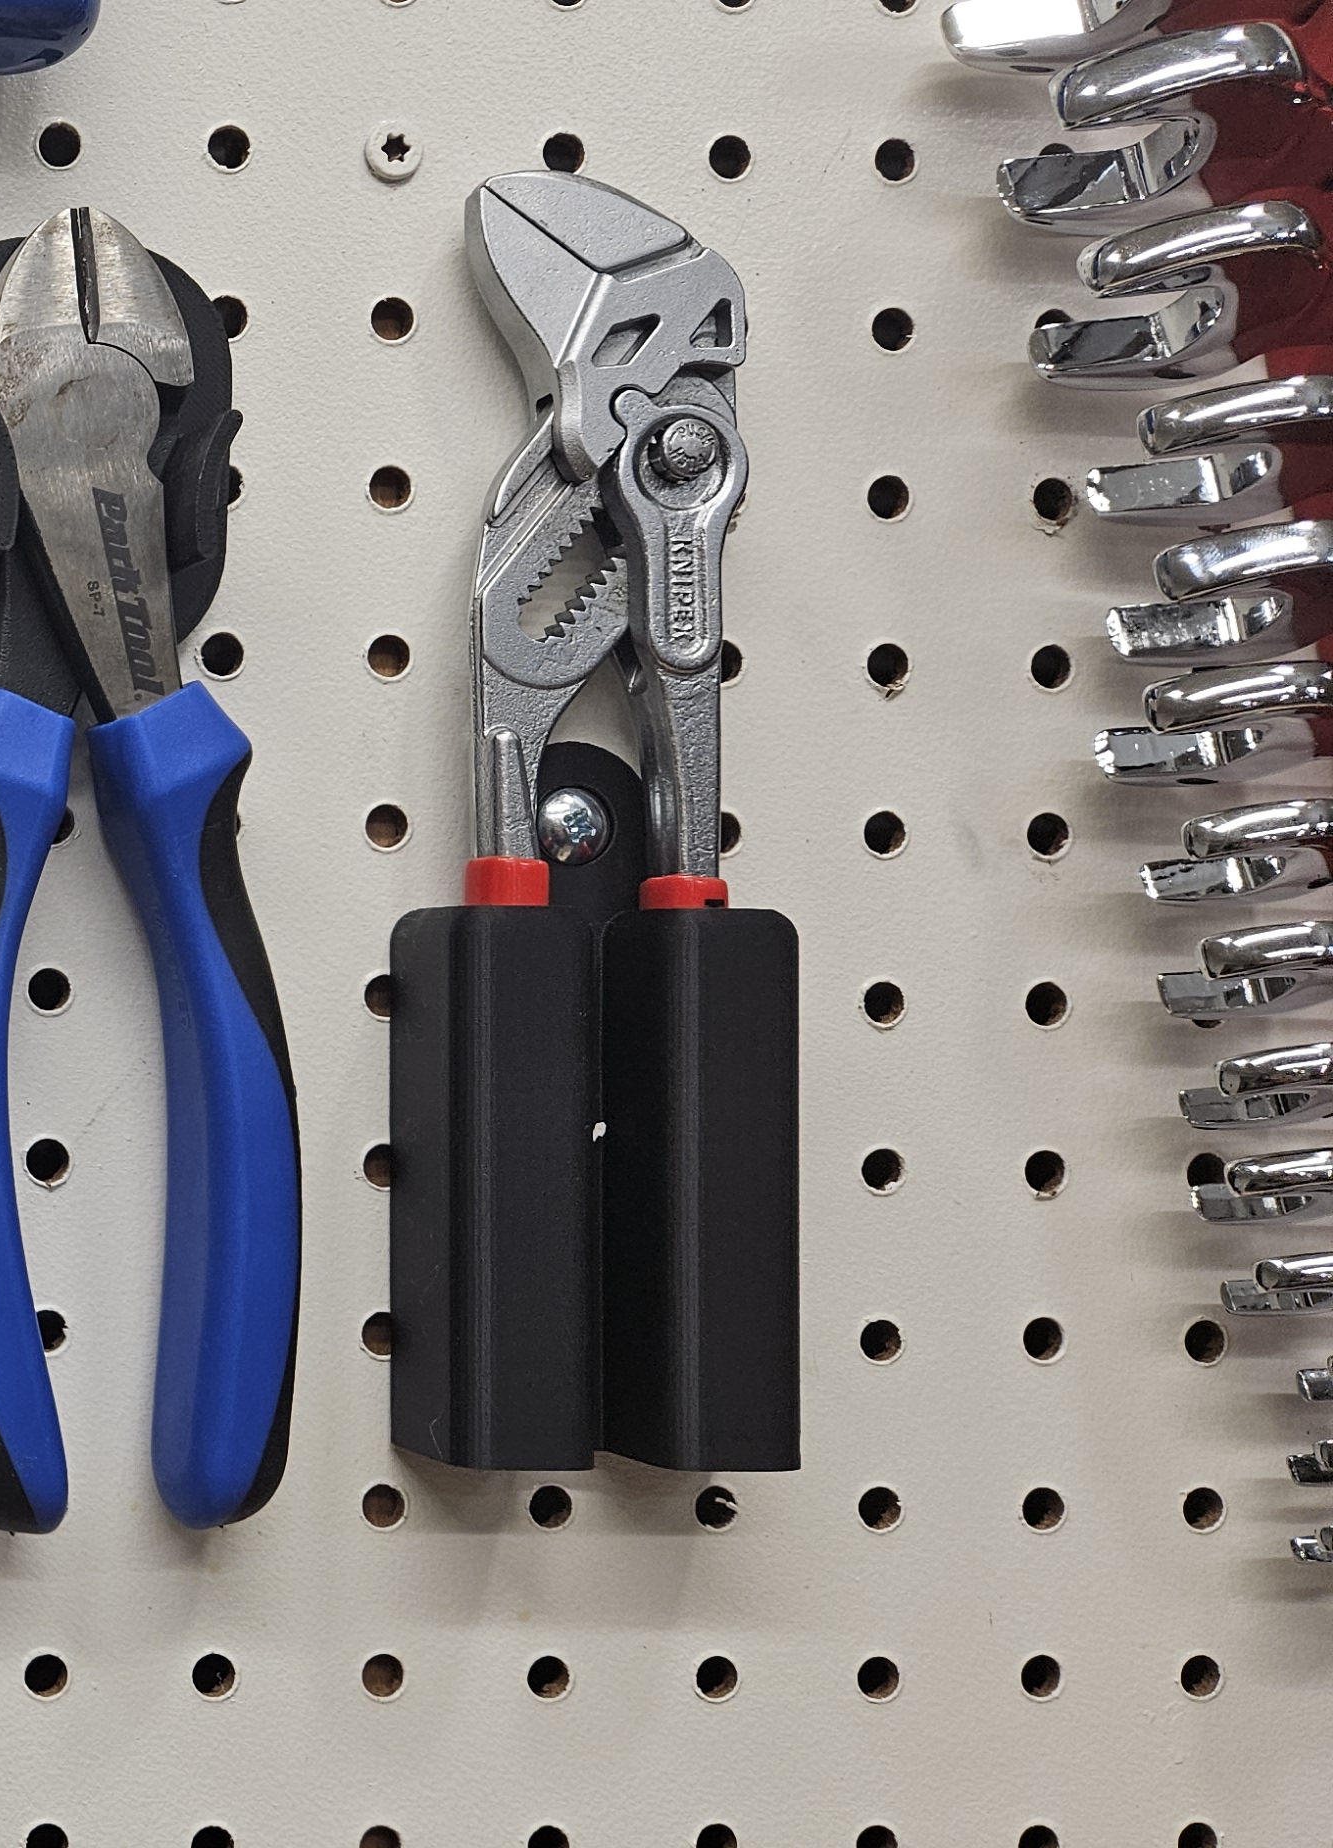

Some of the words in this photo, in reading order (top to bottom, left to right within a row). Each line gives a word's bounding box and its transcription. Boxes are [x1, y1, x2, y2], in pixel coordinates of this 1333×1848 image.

[668, 423, 715, 446] PUSH
[87, 580, 105, 617] SP-7
[670, 538, 694, 642] KNIPEX
